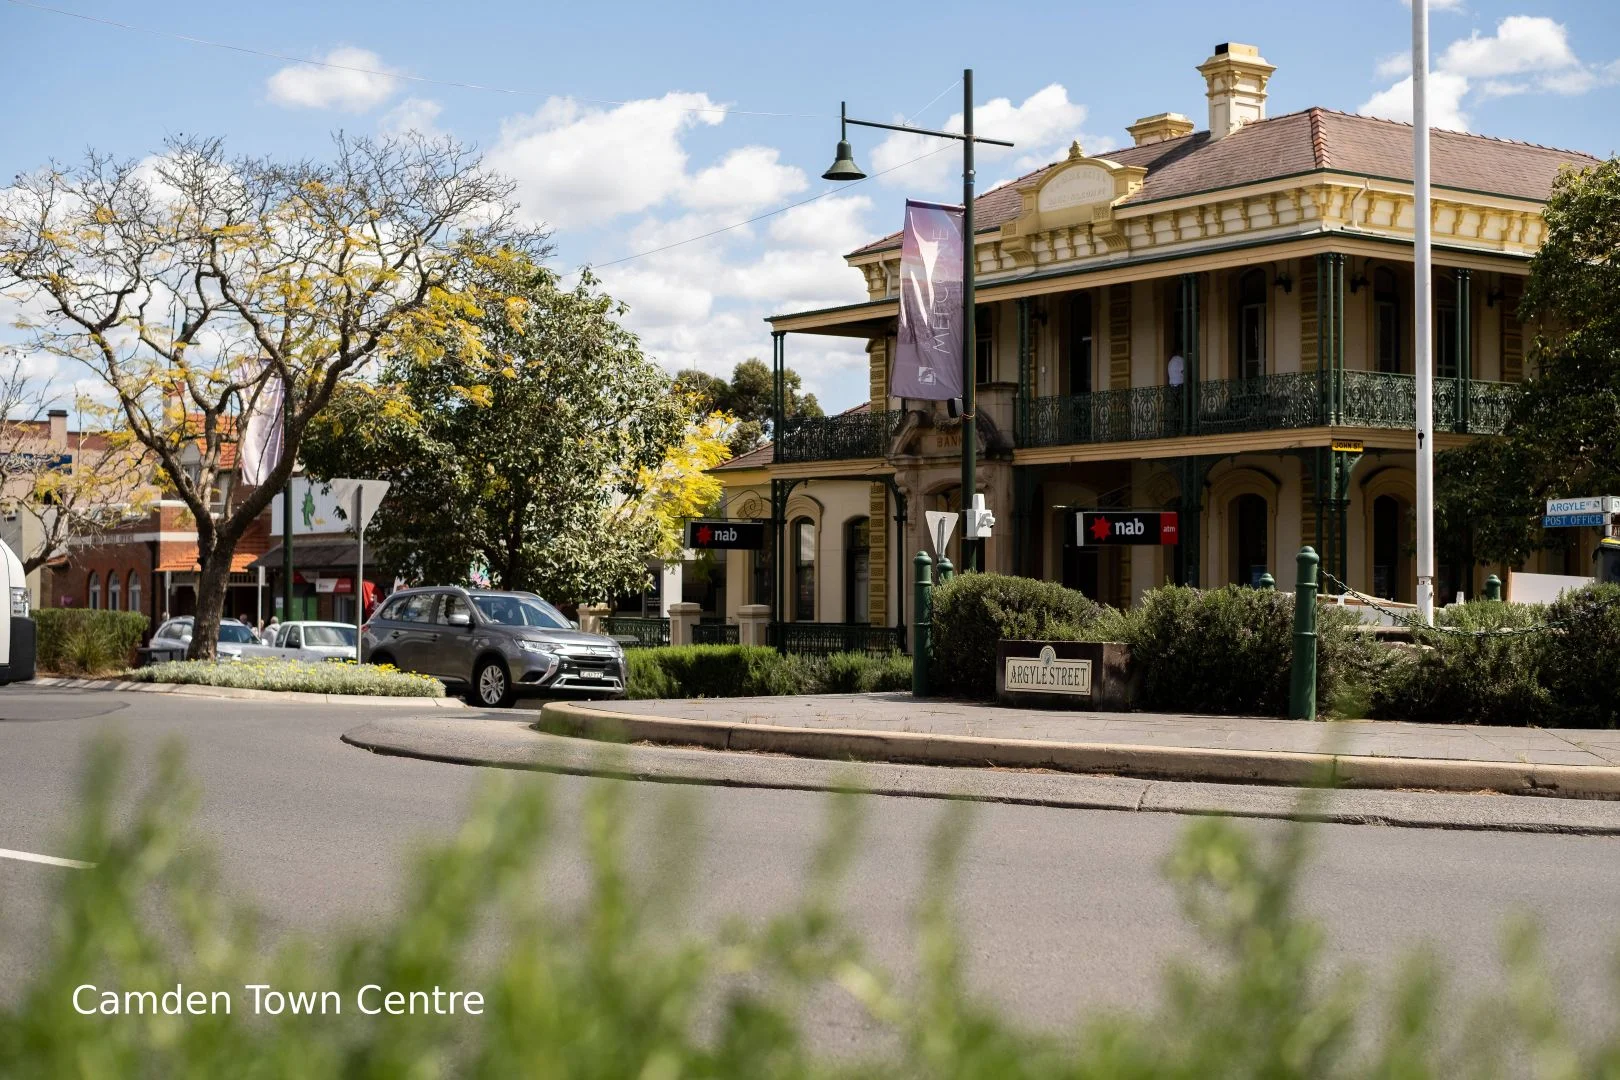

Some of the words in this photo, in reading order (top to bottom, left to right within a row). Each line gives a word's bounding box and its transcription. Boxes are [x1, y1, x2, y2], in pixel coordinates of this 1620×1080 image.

[1334, 441, 1352, 449] JOHN
[1550, 501, 1585, 512] ARGYLE
[1545, 515, 1567, 526] POST
[1570, 514, 1601, 525] OFFICE
[1115, 518, 1145, 535] nab
[1163, 525, 1176, 533] atm
[714, 527, 738, 542] nab
[1010, 665, 1048, 685] ARGYLE
[1049, 666, 1087, 686] STREET
